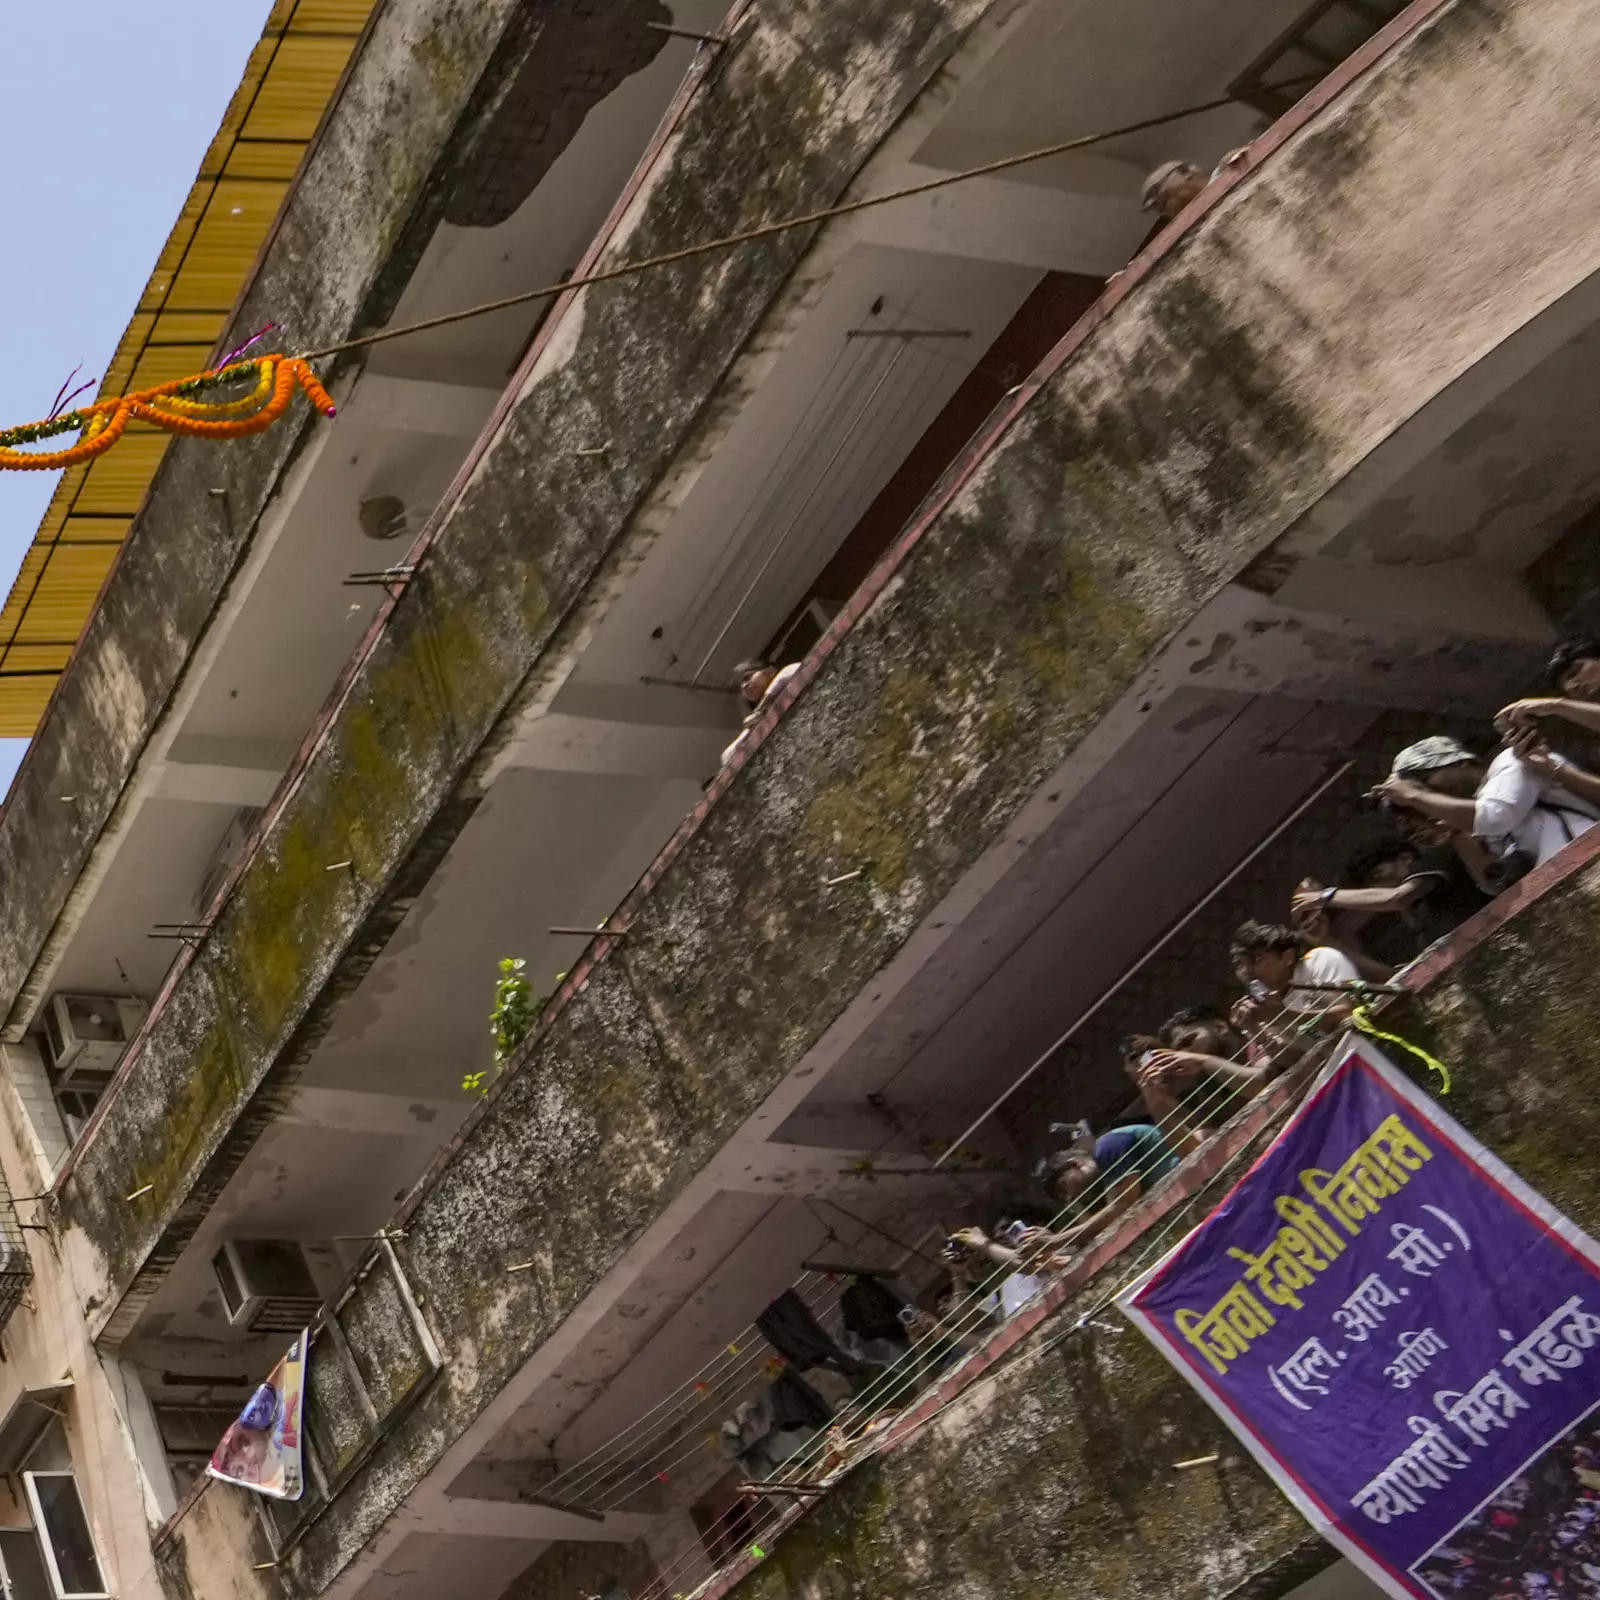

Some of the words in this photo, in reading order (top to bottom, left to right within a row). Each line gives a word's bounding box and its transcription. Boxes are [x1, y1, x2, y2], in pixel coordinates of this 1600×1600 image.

[1176, 1273, 1277, 1376] जिवा
[1228, 1195, 1341, 1311] देवशी
[1300, 1114, 1434, 1232] निवास
[1382, 1328, 1450, 1389] आणि
[1350, 1392, 1470, 1525] व्यापारी
[1434, 1363, 1530, 1453] मित्र
